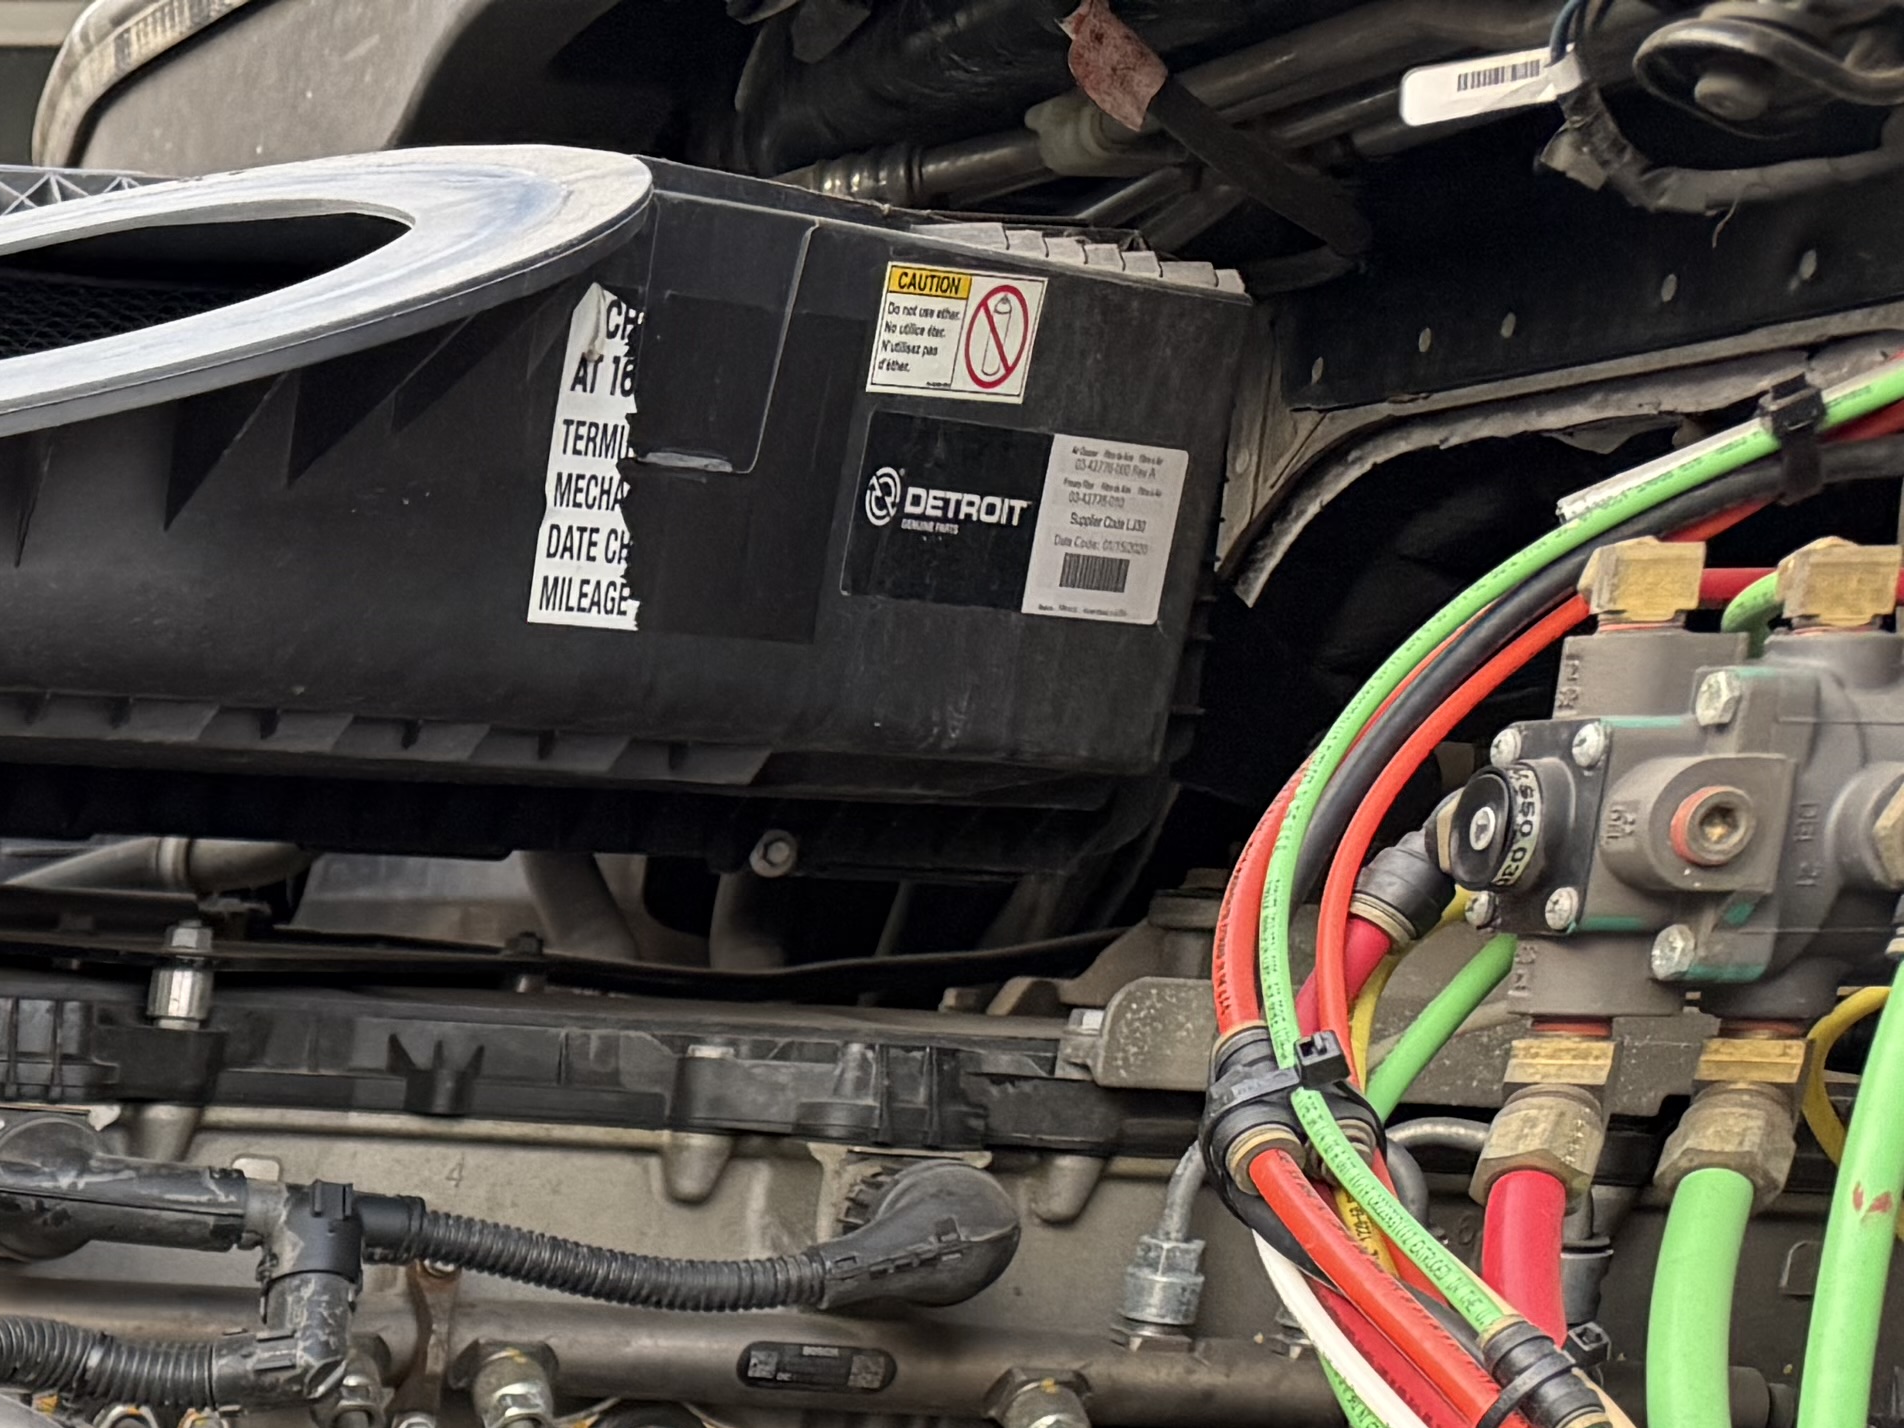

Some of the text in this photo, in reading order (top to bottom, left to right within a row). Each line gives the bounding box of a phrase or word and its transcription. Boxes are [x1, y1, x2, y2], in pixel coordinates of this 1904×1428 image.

[898, 271, 961, 295] CAUTION
[887, 302, 960, 320] Do not use ether.
[884, 321, 897, 333] No
[922, 346, 938, 358] pas
[570, 352, 604, 393] AT
[554, 472, 630, 511] MECHA
[904, 486, 1028, 526] DETROIT
[1070, 512, 1125, 530] Supplier Code
[546, 524, 600, 563] DATE
[539, 575, 630, 617] MILEAGE
